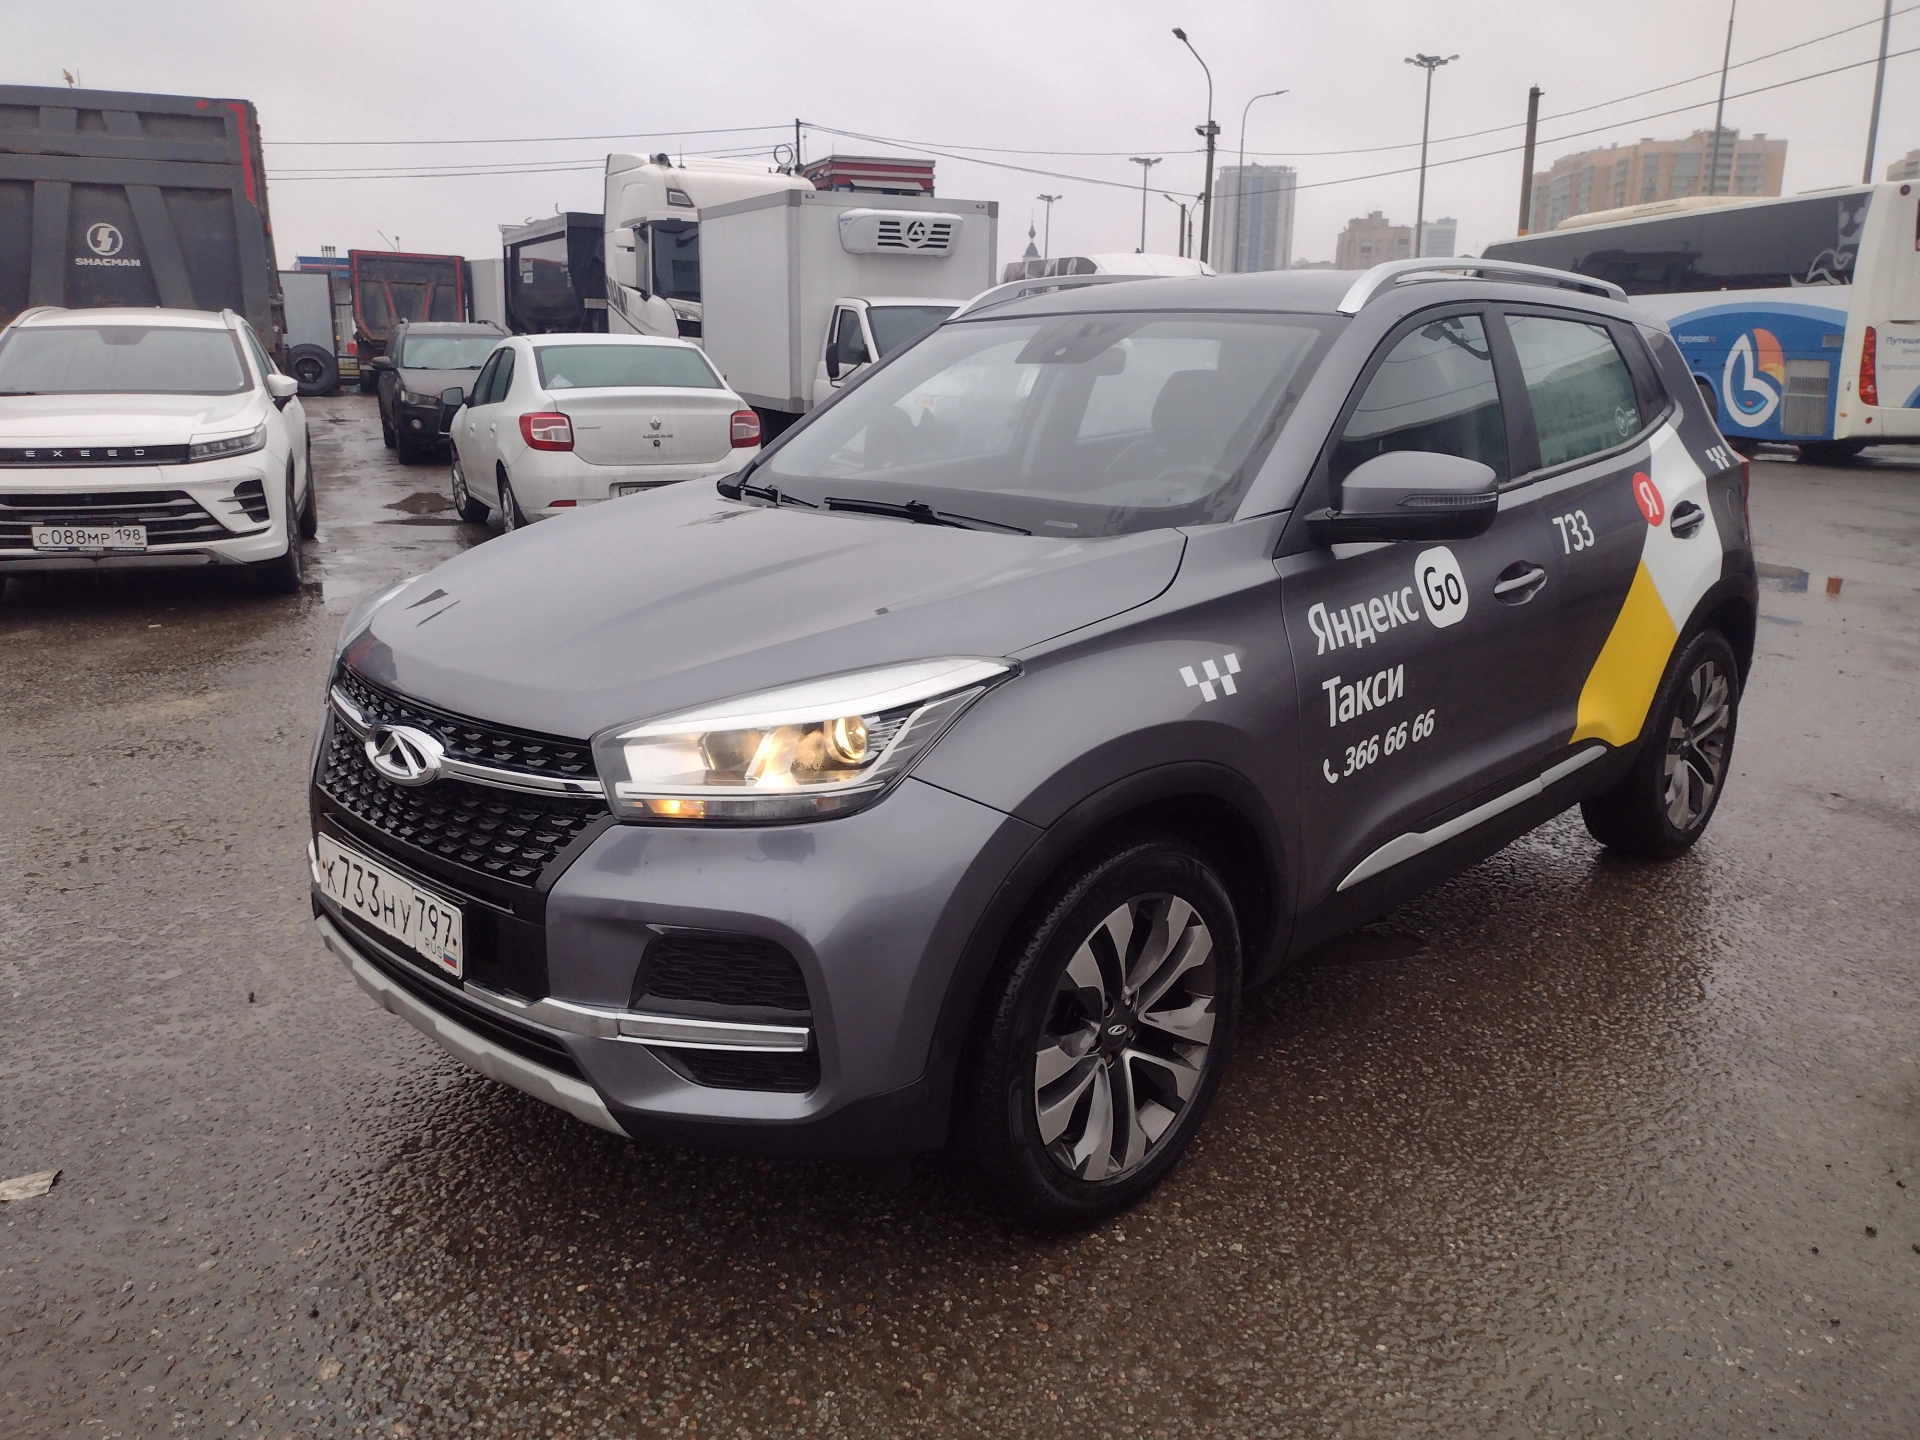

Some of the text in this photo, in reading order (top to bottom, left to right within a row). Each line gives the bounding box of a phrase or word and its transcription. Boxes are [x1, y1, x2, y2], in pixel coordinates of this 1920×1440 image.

[75, 257, 141, 267] SHACMAN
[25, 449, 145, 458] EXEED
[114, 528, 141, 541] 198
[1551, 509, 1595, 555] 733
[1307, 566, 1462, 656] Яндекс Go
[1321, 663, 1405, 728] Такси
[1343, 708, 1436, 777] 366 66 66
[414, 894, 452, 948] 797
[424, 936, 443, 959] RUS
